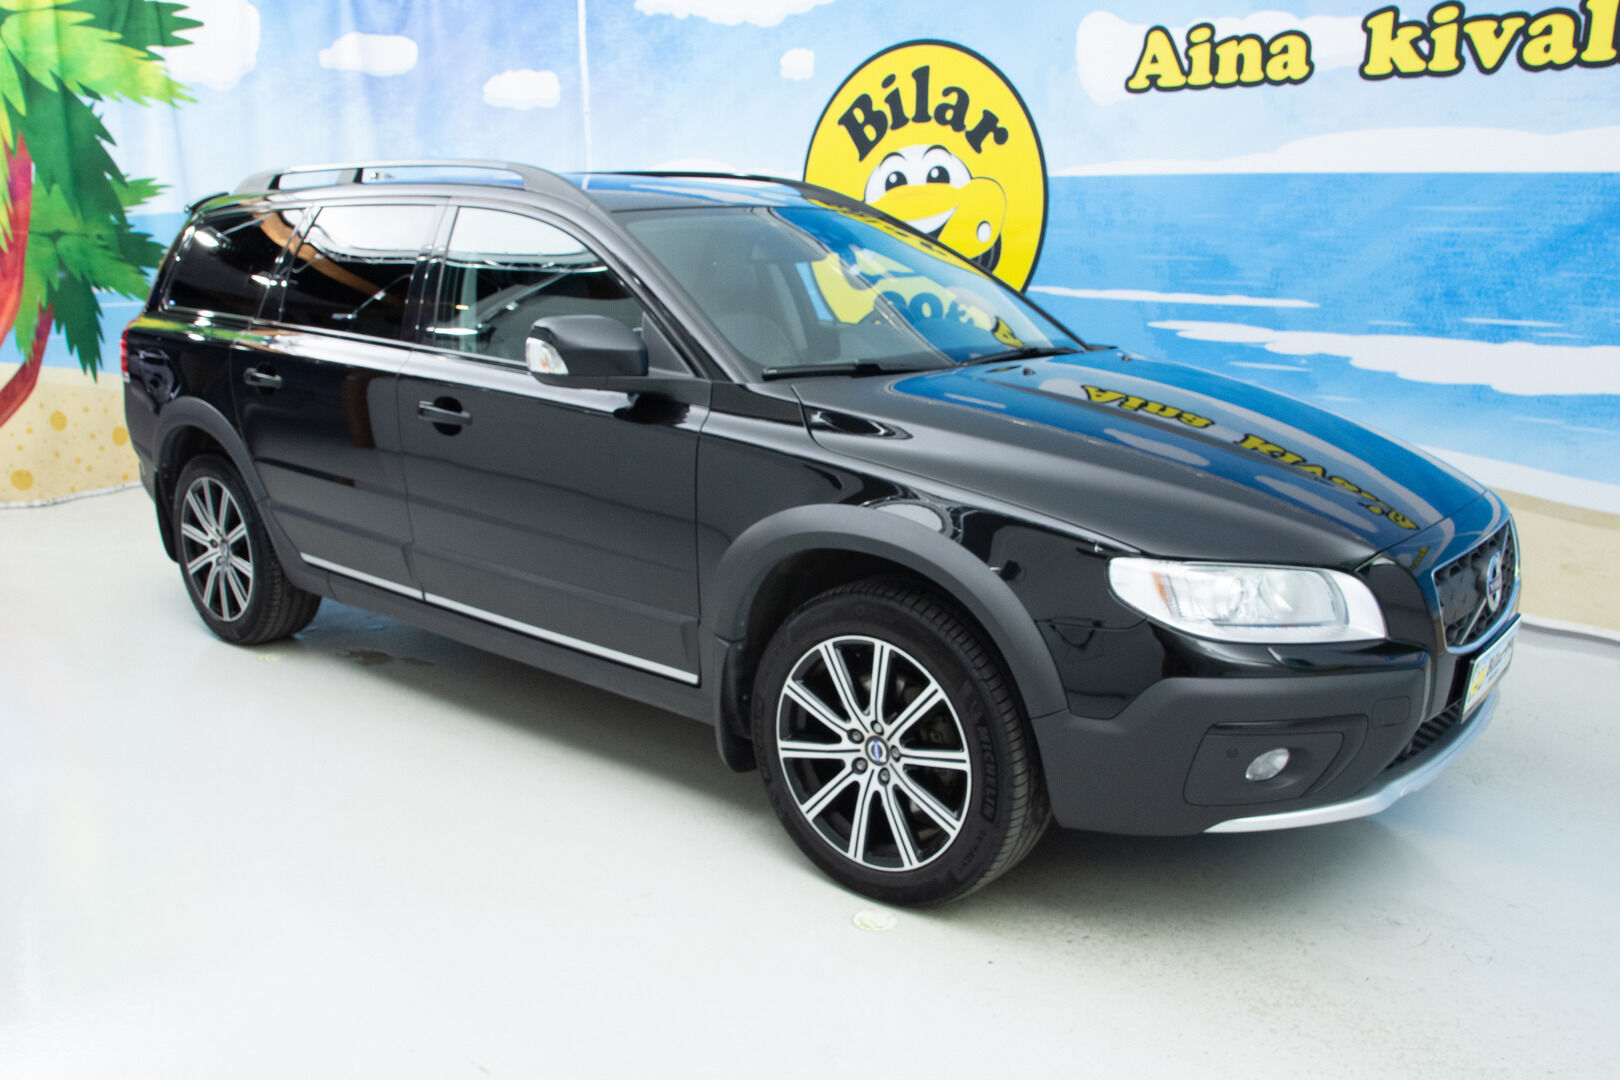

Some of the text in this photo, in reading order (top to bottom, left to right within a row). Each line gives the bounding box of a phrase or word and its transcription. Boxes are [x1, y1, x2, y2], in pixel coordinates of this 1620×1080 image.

[1126, 0, 1620, 93] Aina kival
[837, 64, 1009, 162] Bilar
